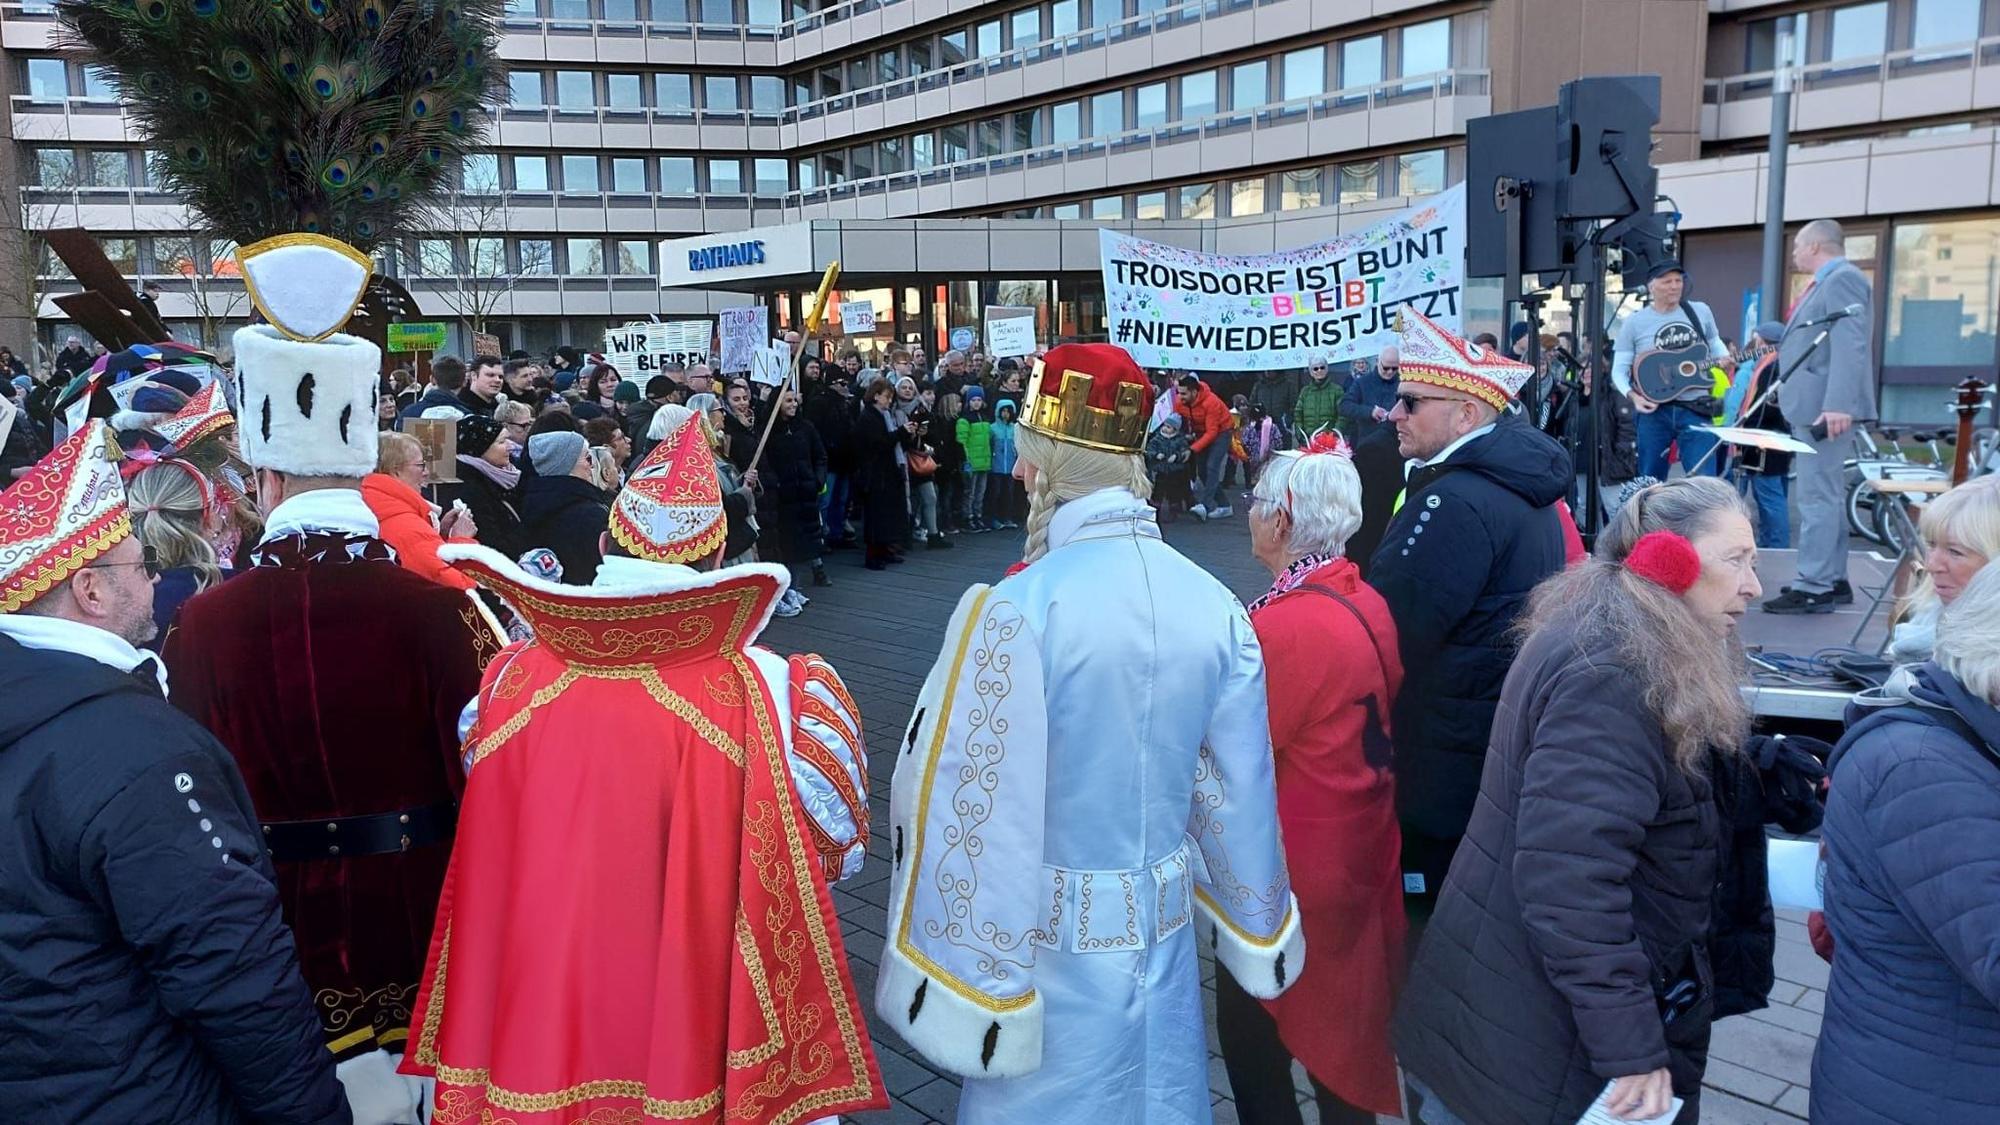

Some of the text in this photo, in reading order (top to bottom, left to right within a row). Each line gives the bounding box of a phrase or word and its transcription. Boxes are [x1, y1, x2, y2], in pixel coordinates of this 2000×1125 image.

[688, 239, 766, 271] RATHAUS
[1111, 226, 1448, 296] TROISDORF IST BUNT
[1271, 277, 1385, 319] BLEIBT
[611, 333, 647, 353] WIR
[80, 469, 99, 509] Michael
